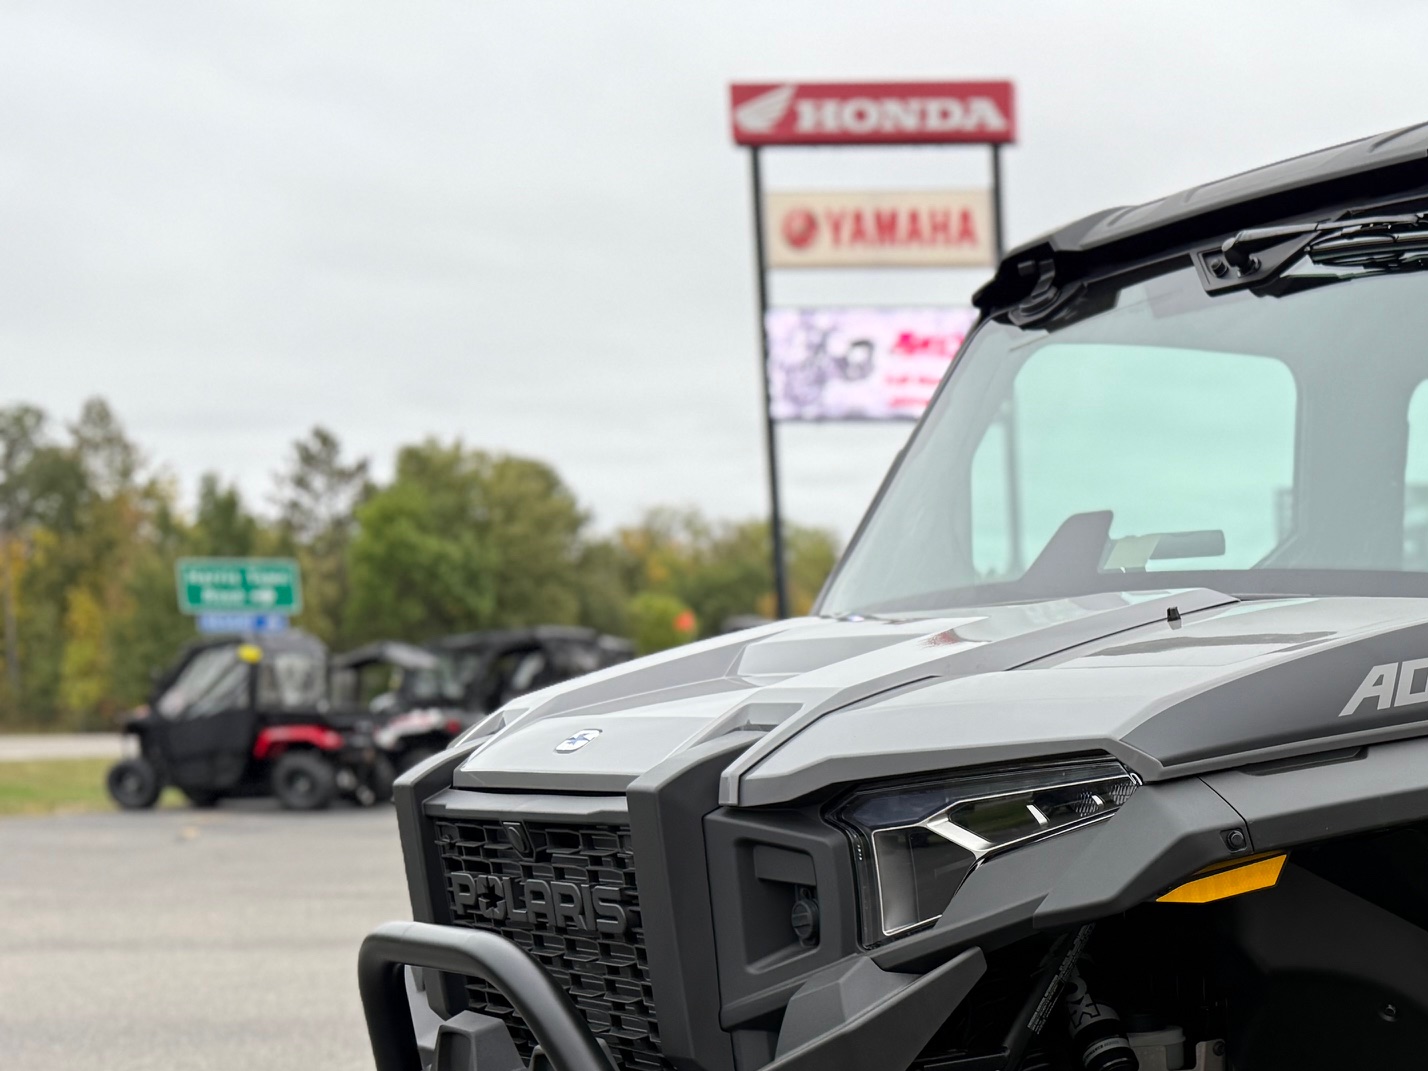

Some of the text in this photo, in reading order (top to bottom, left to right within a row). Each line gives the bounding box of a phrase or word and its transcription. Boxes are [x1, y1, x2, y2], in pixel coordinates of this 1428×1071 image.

[798, 96, 1007, 133] HONDA
[826, 208, 978, 246] YAMAHA
[451, 872, 628, 934] POLARIS
